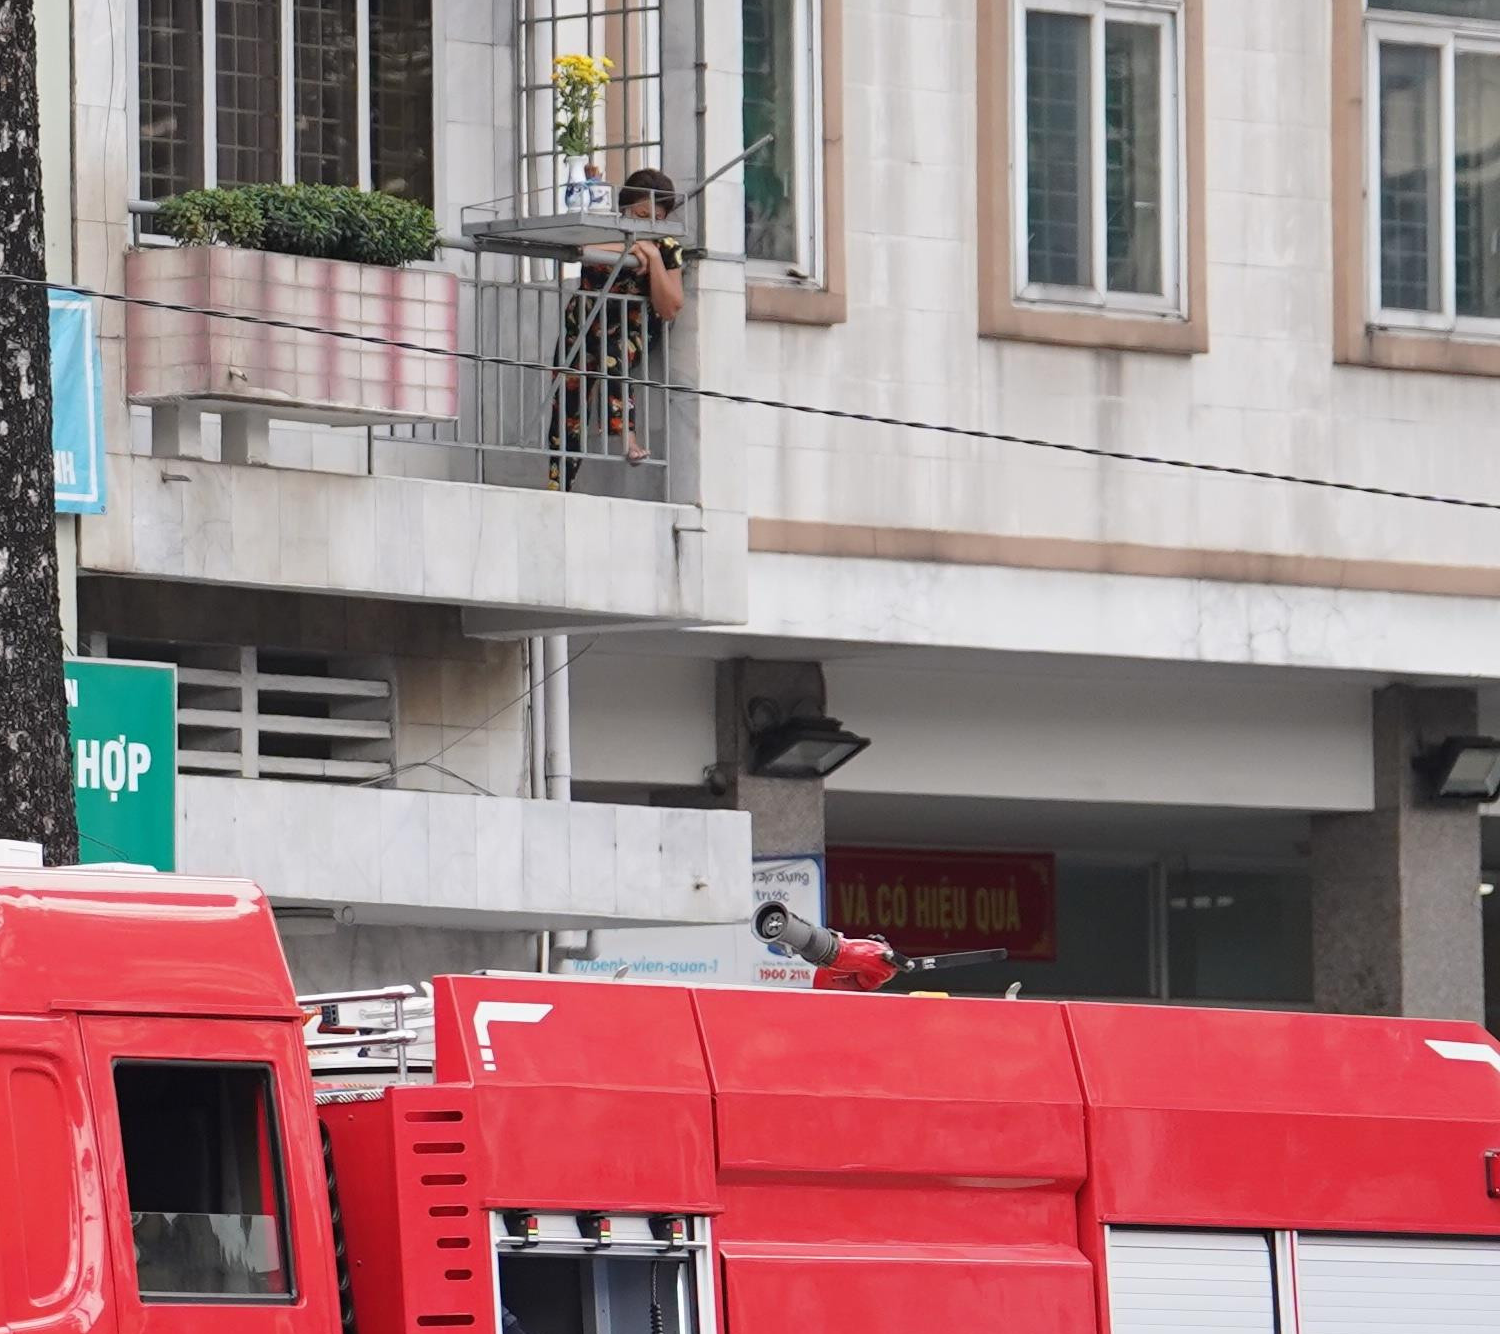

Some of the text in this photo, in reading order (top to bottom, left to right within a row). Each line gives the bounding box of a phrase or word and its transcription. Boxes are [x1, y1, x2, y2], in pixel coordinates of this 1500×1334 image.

[78, 735, 152, 803] HỢP
[840, 873, 870, 926] VÀ
[876, 874, 908, 928] CÓ
[915, 877, 968, 938] HIỆU
[759, 969, 786, 980] 1900
